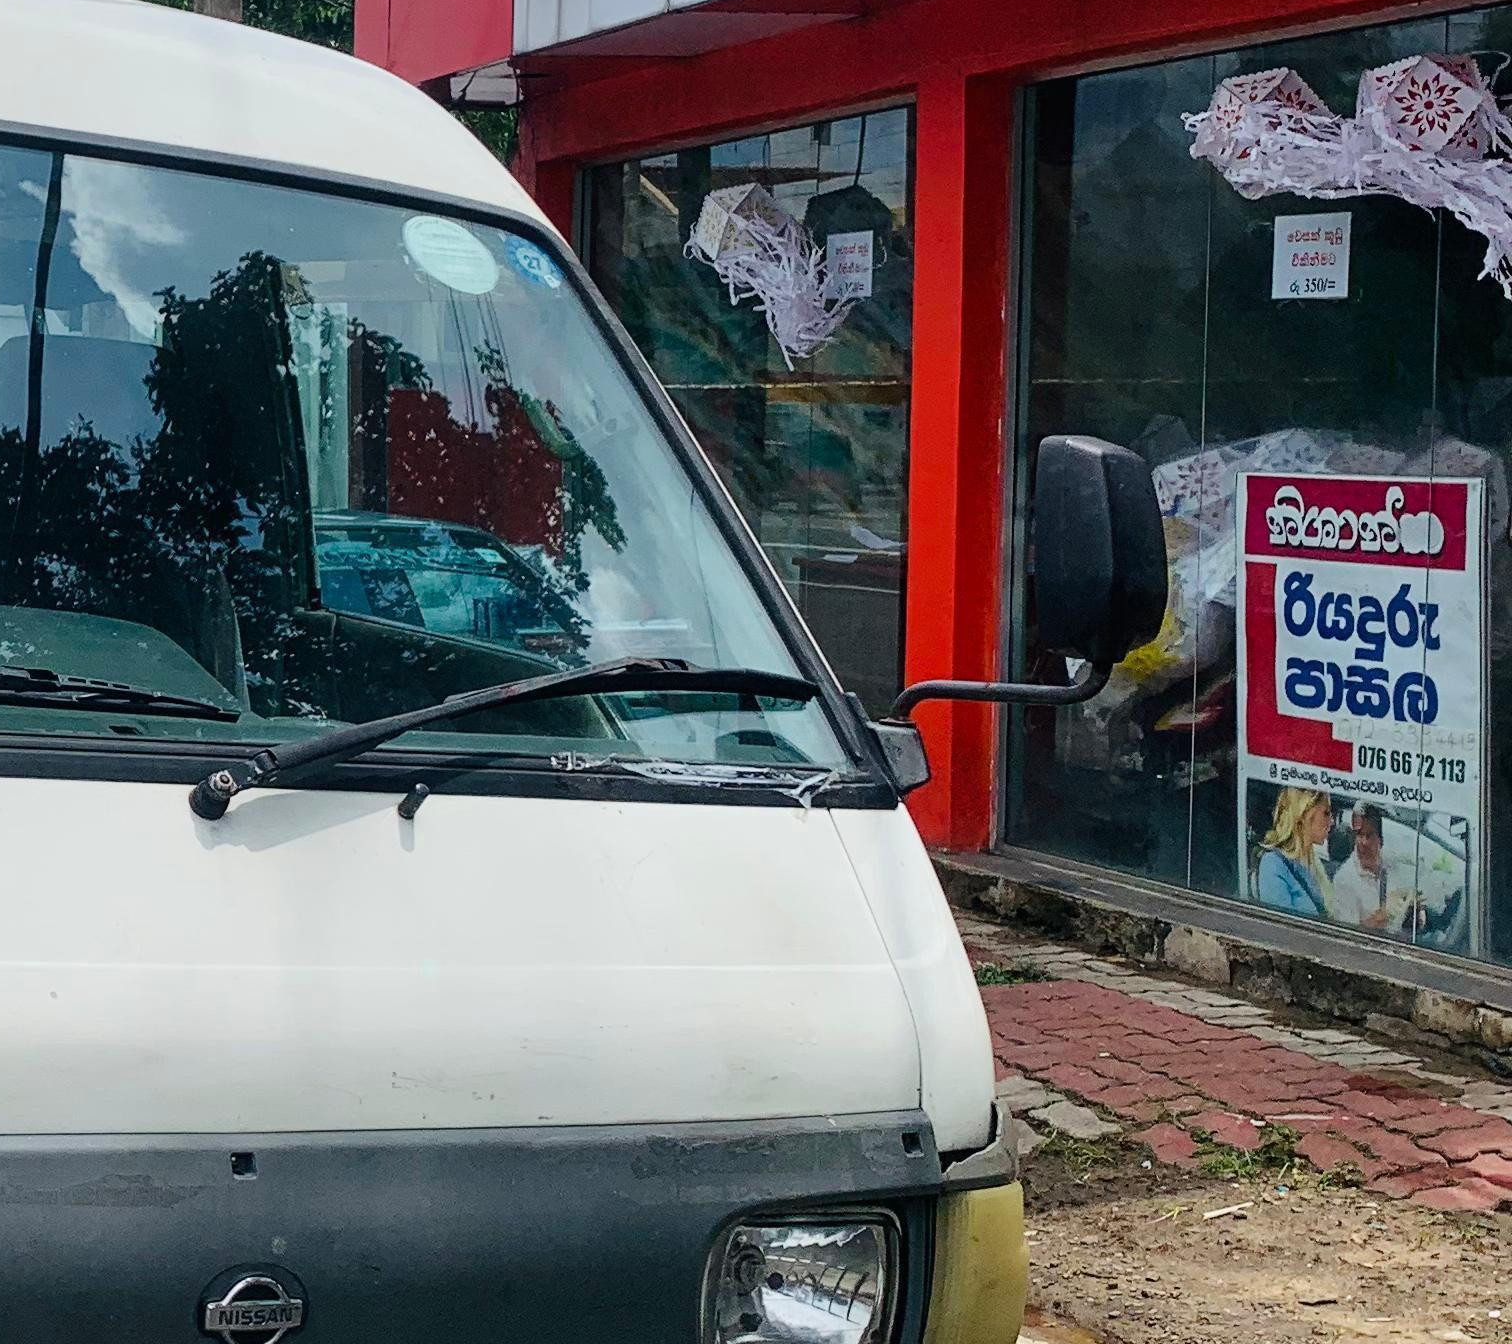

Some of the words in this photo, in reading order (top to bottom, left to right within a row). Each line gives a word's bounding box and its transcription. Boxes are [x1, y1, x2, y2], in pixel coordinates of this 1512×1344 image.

[1304, 277, 1336, 293] 350/=
[1283, 571, 1441, 662] රියදුරු
[1285, 657, 1439, 725] පාසල
[1357, 745, 1387, 771] 076
[1390, 751, 1412, 775] 66
[1416, 754, 1435, 779] 72
[1438, 758, 1466, 784] 113
[219, 1307, 293, 1326] NISSAN
